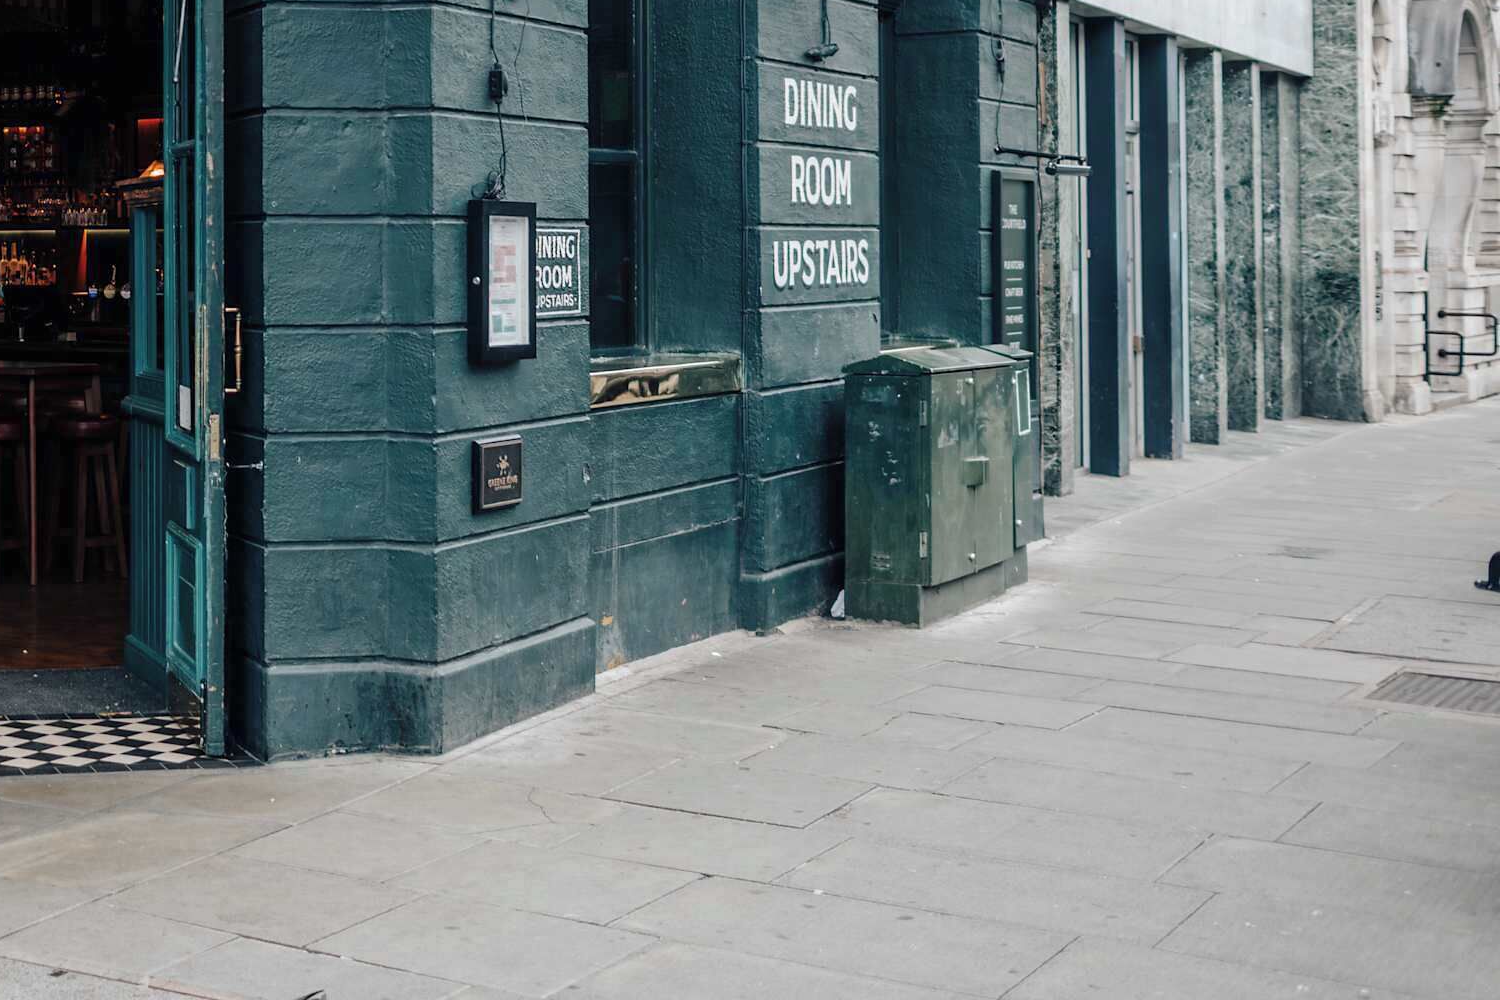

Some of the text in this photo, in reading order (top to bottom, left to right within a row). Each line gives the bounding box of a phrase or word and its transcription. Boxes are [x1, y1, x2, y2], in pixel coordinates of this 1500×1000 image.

[784, 77, 857, 131] DINING
[791, 155, 851, 206] ROOM
[536, 235, 575, 259] INING
[773, 239, 869, 289] UPSTAIRS
[536, 265, 573, 289] ROOM
